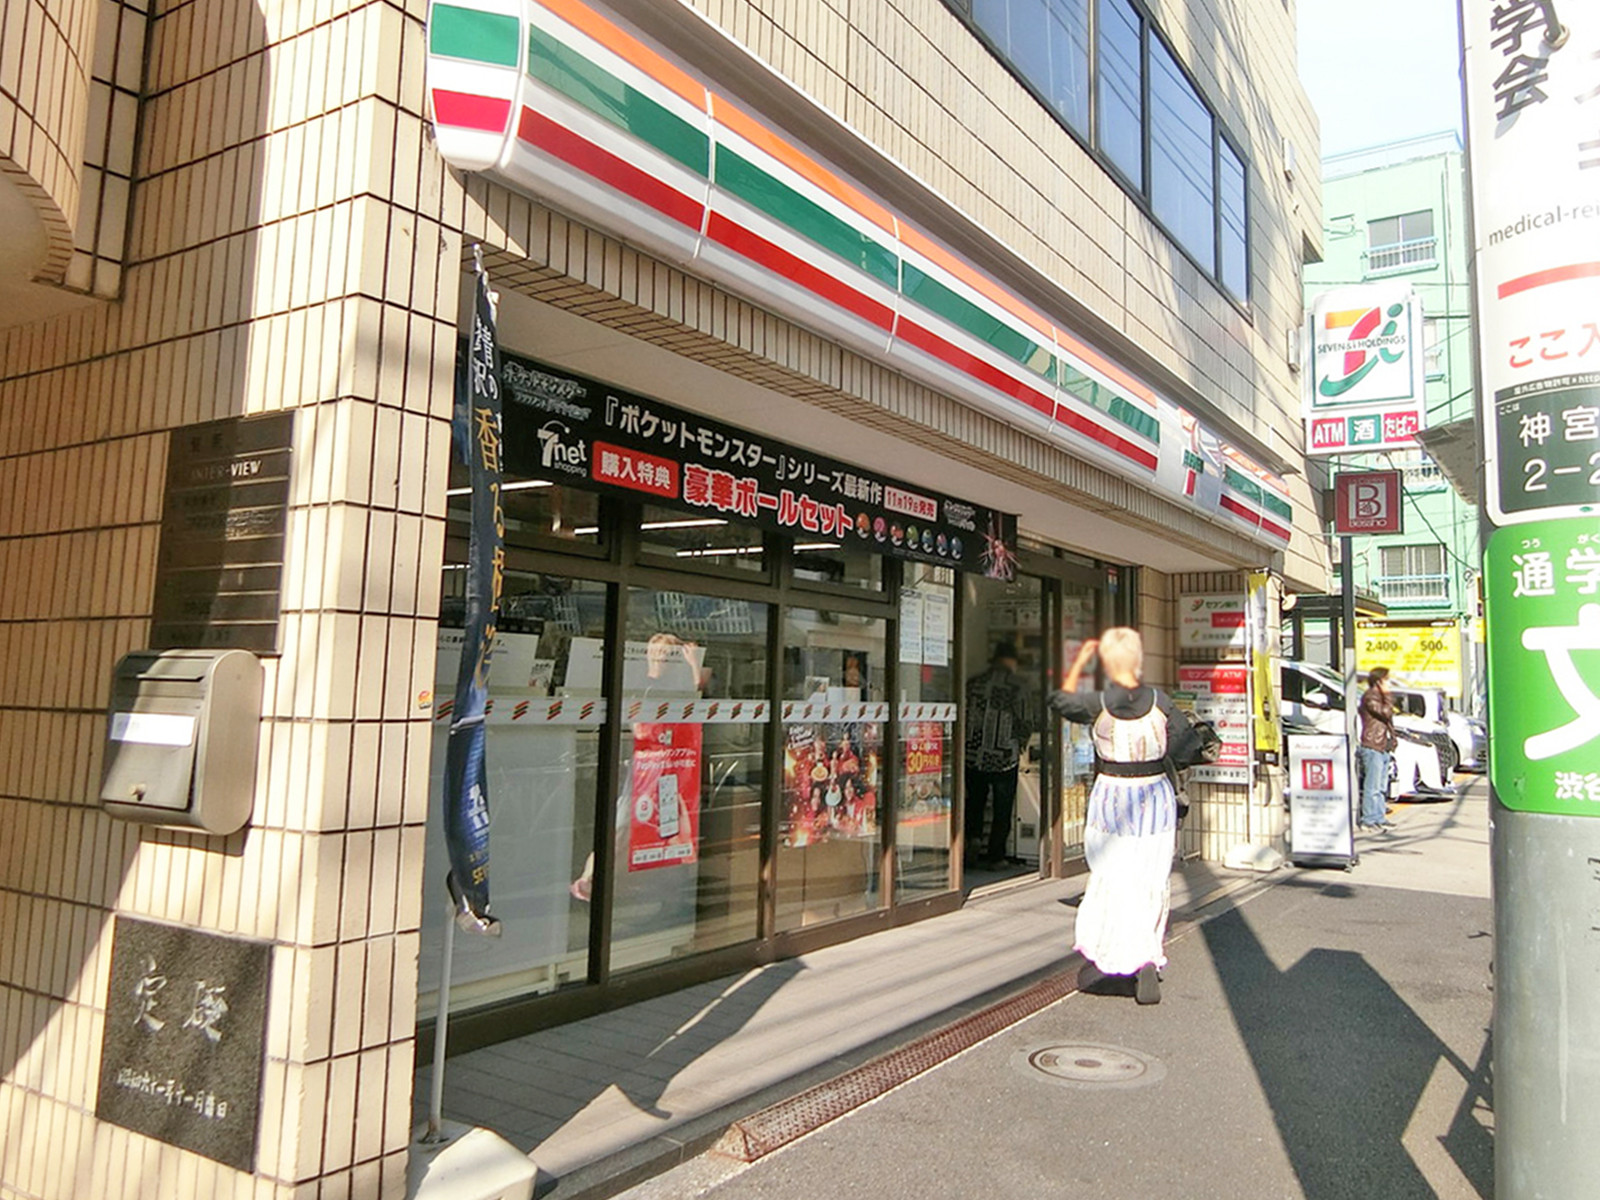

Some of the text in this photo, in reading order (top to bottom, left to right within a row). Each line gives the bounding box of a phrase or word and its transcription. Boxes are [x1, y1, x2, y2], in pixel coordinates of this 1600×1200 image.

[1314, 422, 1345, 444] ATM
[1353, 419, 1376, 442] 酒
[1384, 415, 1418, 439] たばこ
[553, 461, 588, 478] shopping
[600, 450, 672, 490] 購入特典
[683, 463, 854, 538] 豪華ボールセット
[1511, 547, 1600, 598] 通学
